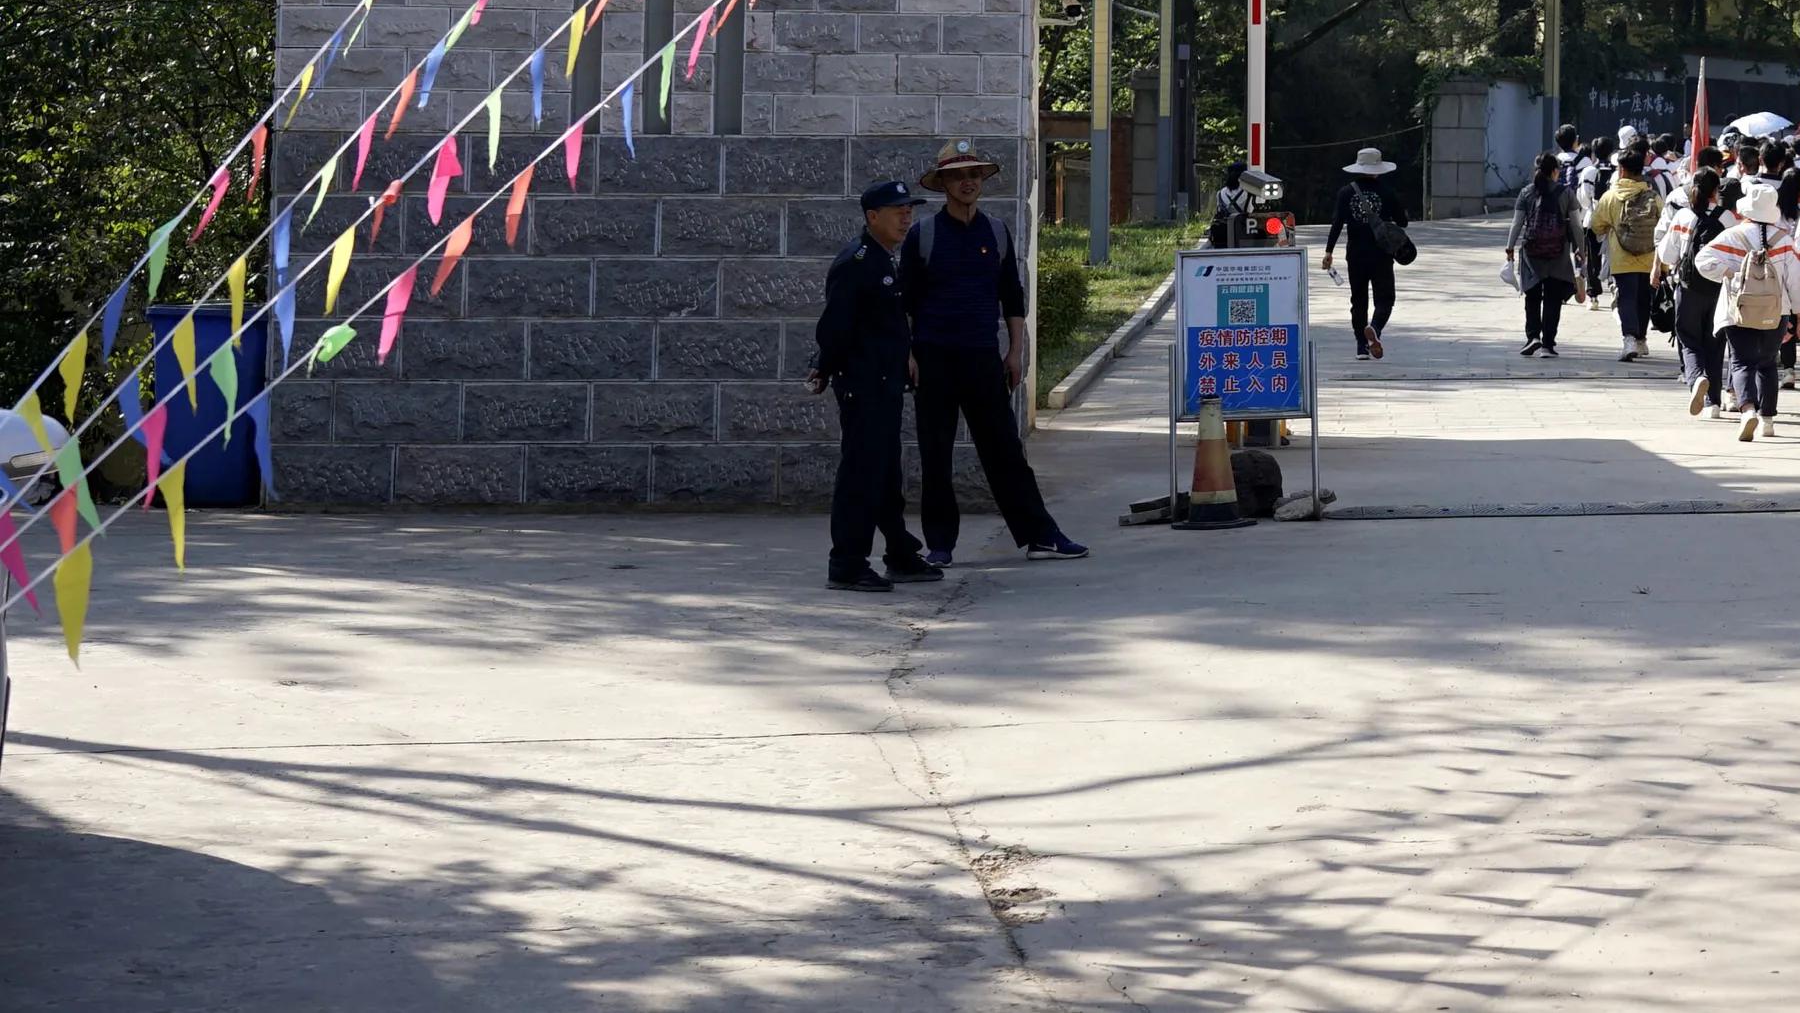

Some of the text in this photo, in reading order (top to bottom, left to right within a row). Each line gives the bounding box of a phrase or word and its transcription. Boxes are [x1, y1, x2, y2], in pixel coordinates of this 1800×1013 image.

[1199, 327, 1288, 347] 疫情防控期
[1199, 350, 1288, 371] 外来人员
[1199, 374, 1287, 395] 禁止入内
